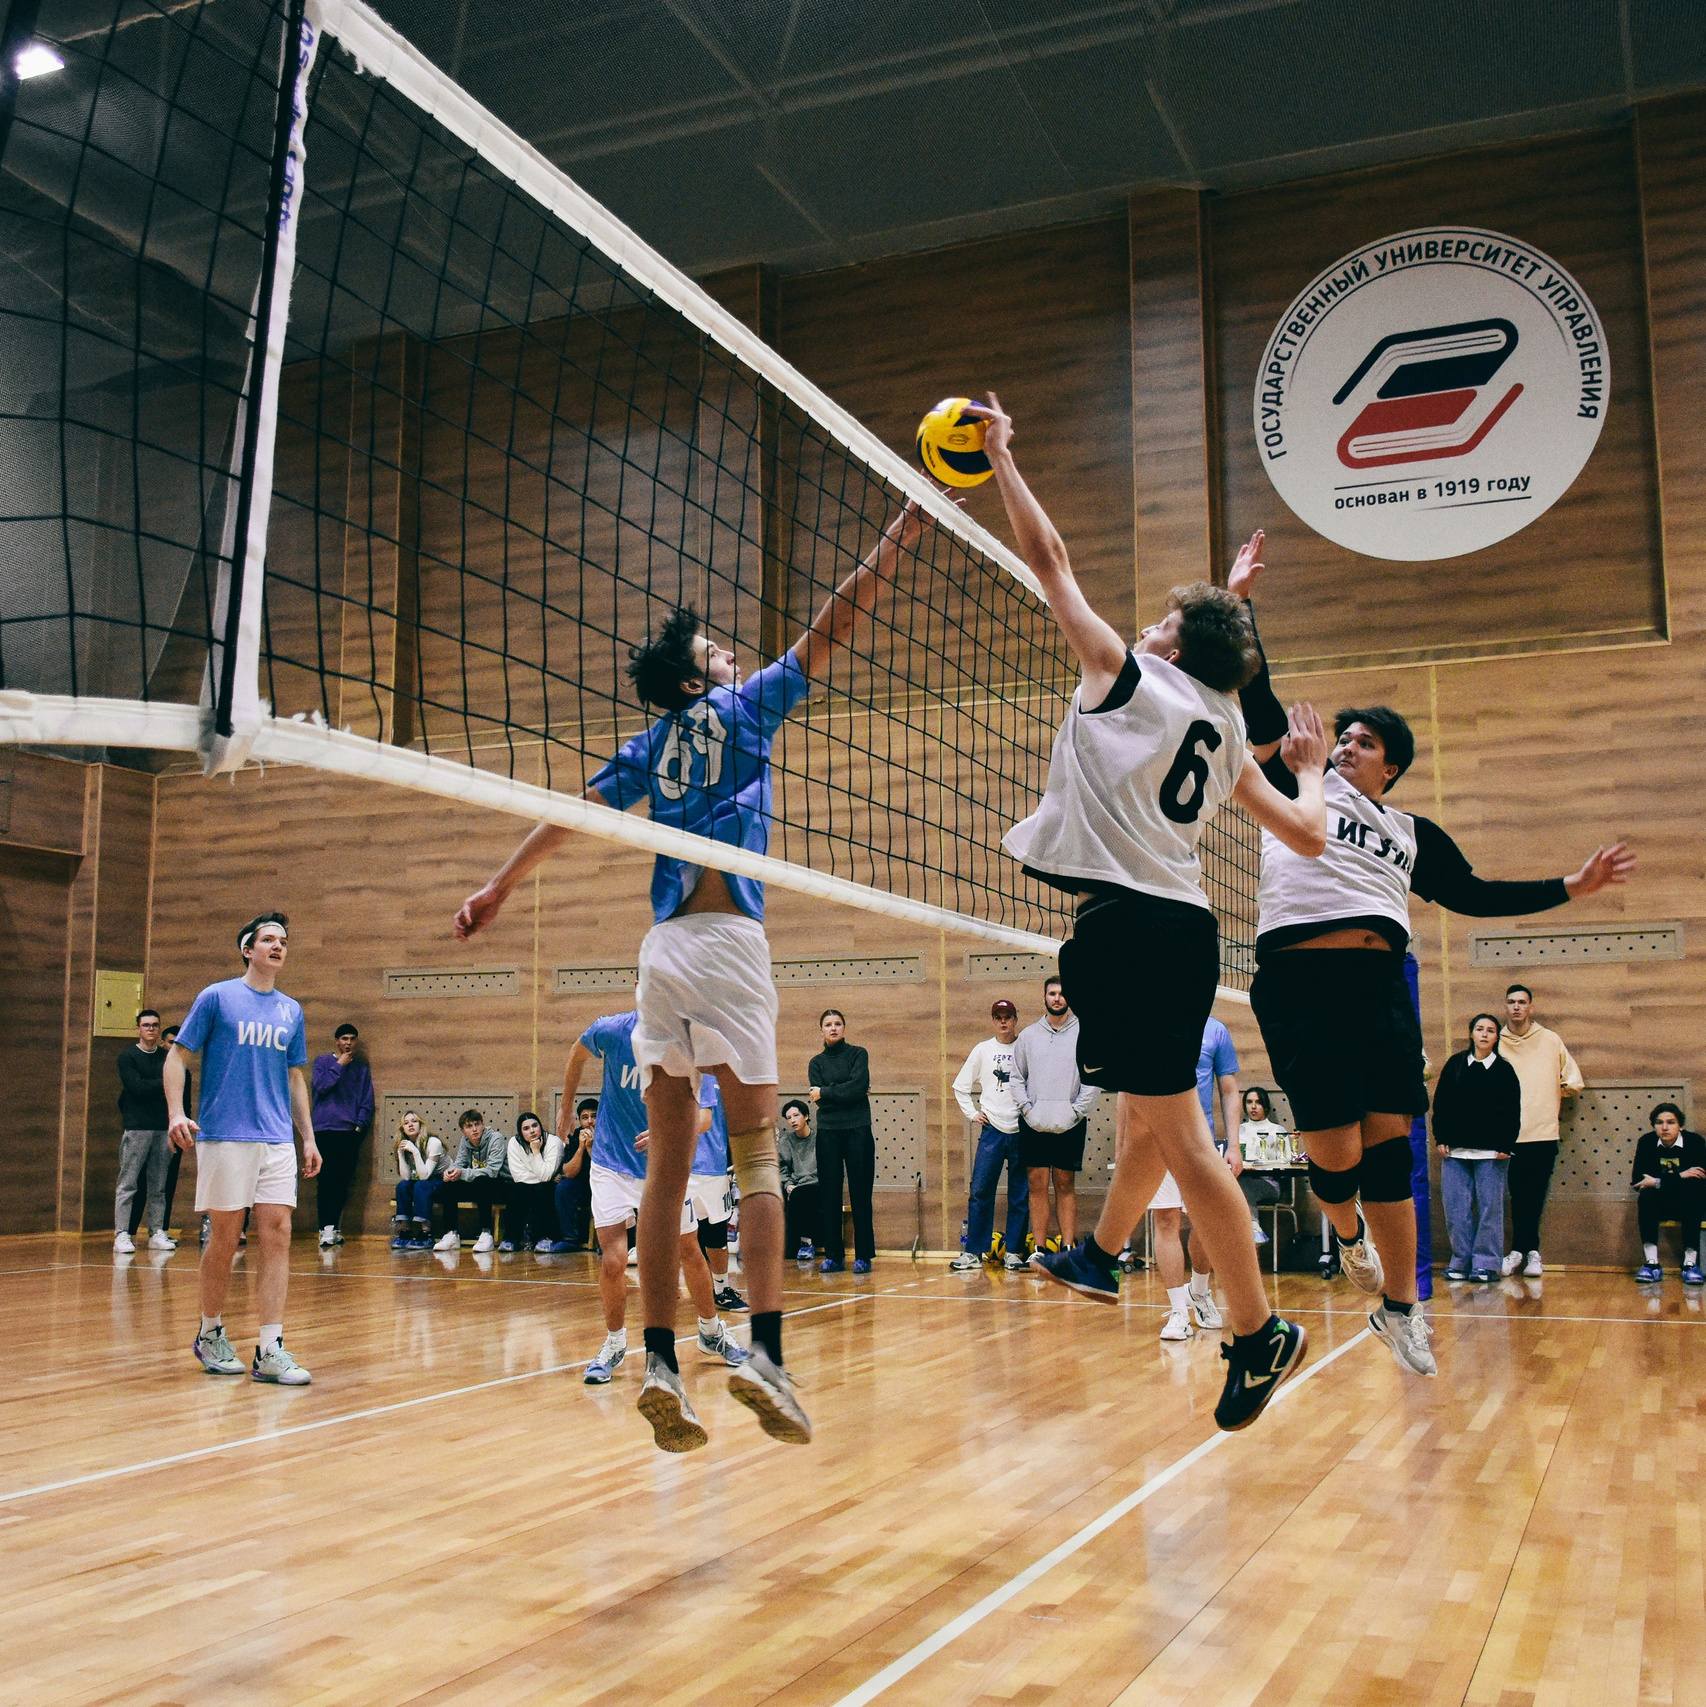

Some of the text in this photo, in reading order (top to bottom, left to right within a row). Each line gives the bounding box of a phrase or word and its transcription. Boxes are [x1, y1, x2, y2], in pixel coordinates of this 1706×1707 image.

[1261, 239, 1603, 460] ГОСУДАРСТВЕННЫЙ УНИВЕРСИТЕТ УПРАВЛЕНИЯ
[1334, 475, 1531, 510] основан в 1919 году
[1159, 719, 1222, 824] 6
[238, 1020, 288, 1051] ИИС
